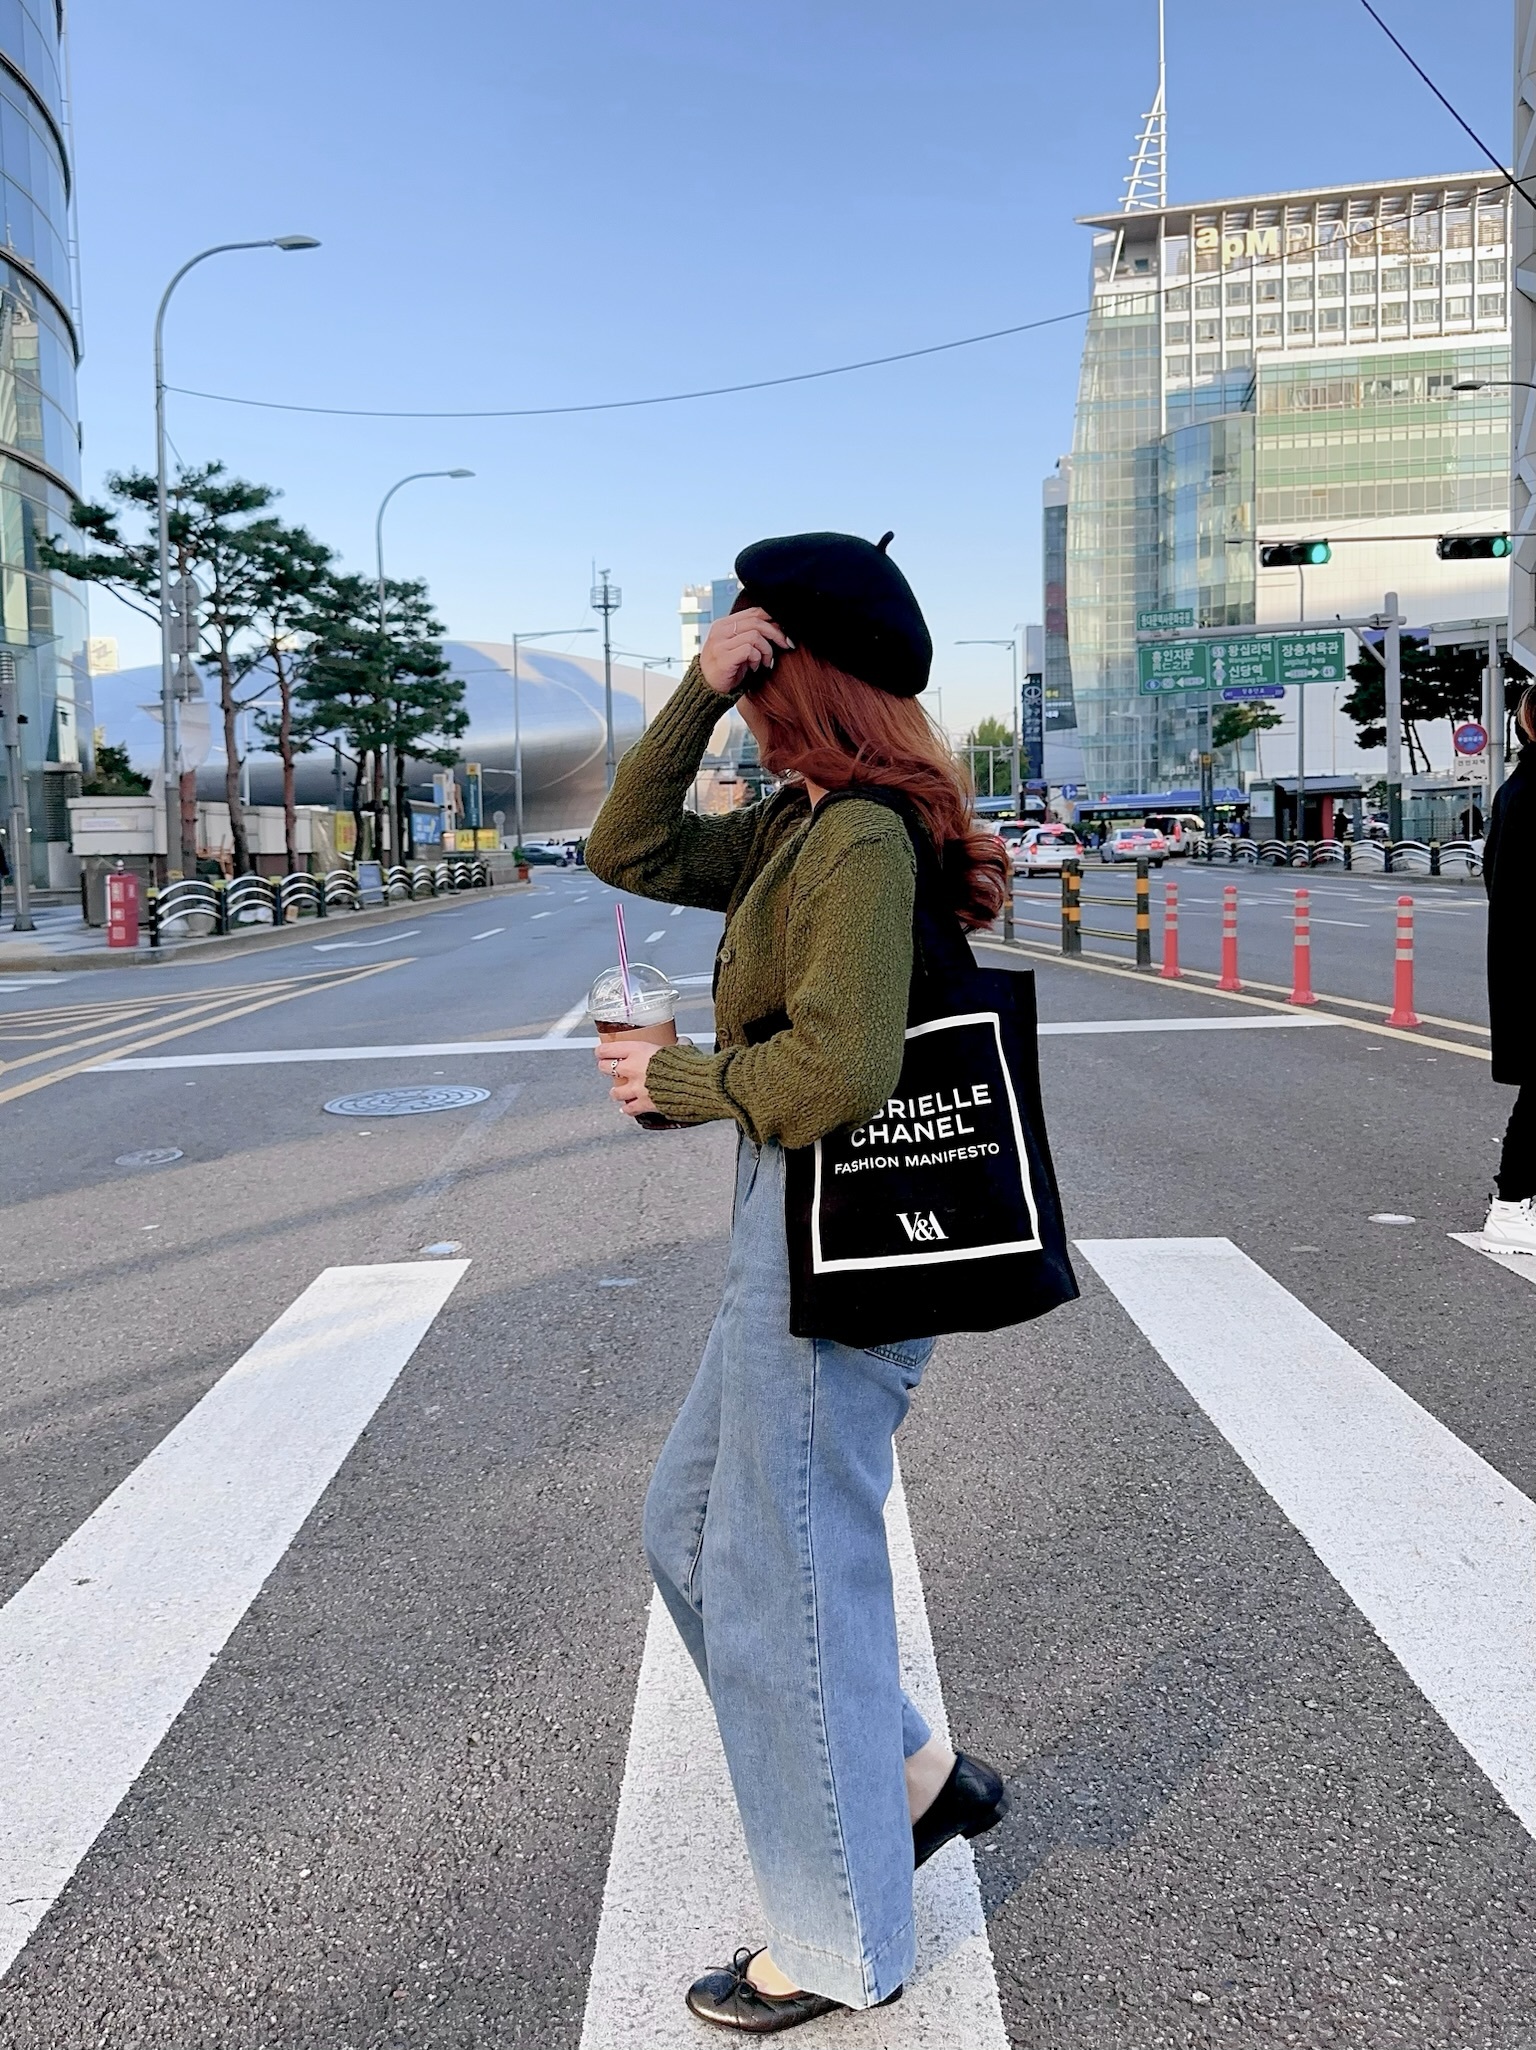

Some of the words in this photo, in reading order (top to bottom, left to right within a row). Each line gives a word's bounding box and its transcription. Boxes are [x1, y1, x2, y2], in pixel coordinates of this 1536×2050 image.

[1196, 226, 1278, 264] apM
[1284, 218, 1394, 253] PLACE
[1228, 642, 1272, 657] 왕십리역
[1281, 640, 1339, 658] 장충체육관
[1228, 664, 1263, 678] 신당역
[871, 1083, 993, 1119] RIELLE
[850, 1113, 975, 1148] CHANEL
[834, 1155, 899, 1175] FASHION
[904, 1142, 1000, 1168] MANIFESTO
[896, 1211, 949, 1242] V&A
